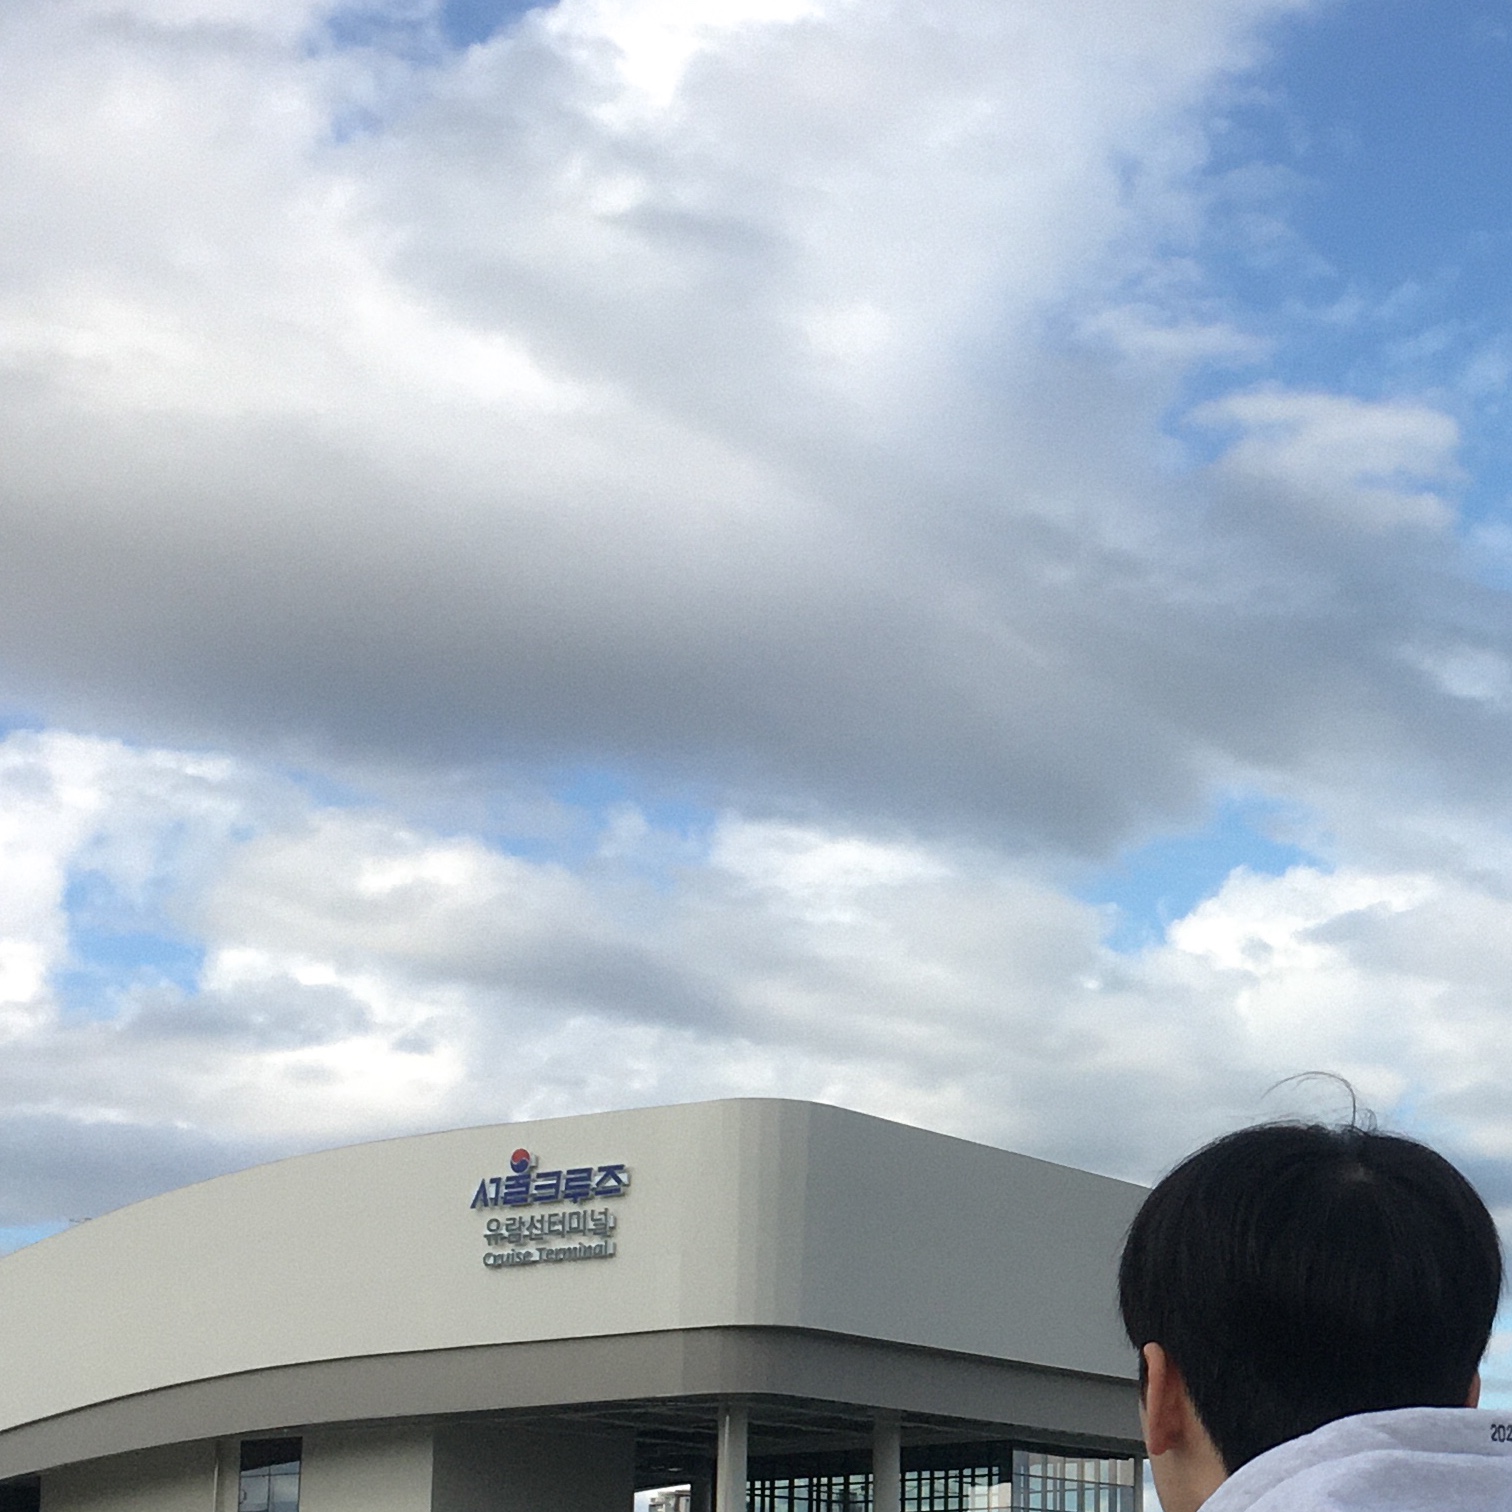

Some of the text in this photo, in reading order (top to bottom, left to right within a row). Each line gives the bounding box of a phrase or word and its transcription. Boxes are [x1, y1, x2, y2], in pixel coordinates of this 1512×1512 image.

[470, 1148, 628, 1209] 서울크루즈
[484, 1207, 614, 1246] 유람선터미널
[482, 1239, 612, 1268] Cruise Terminal
